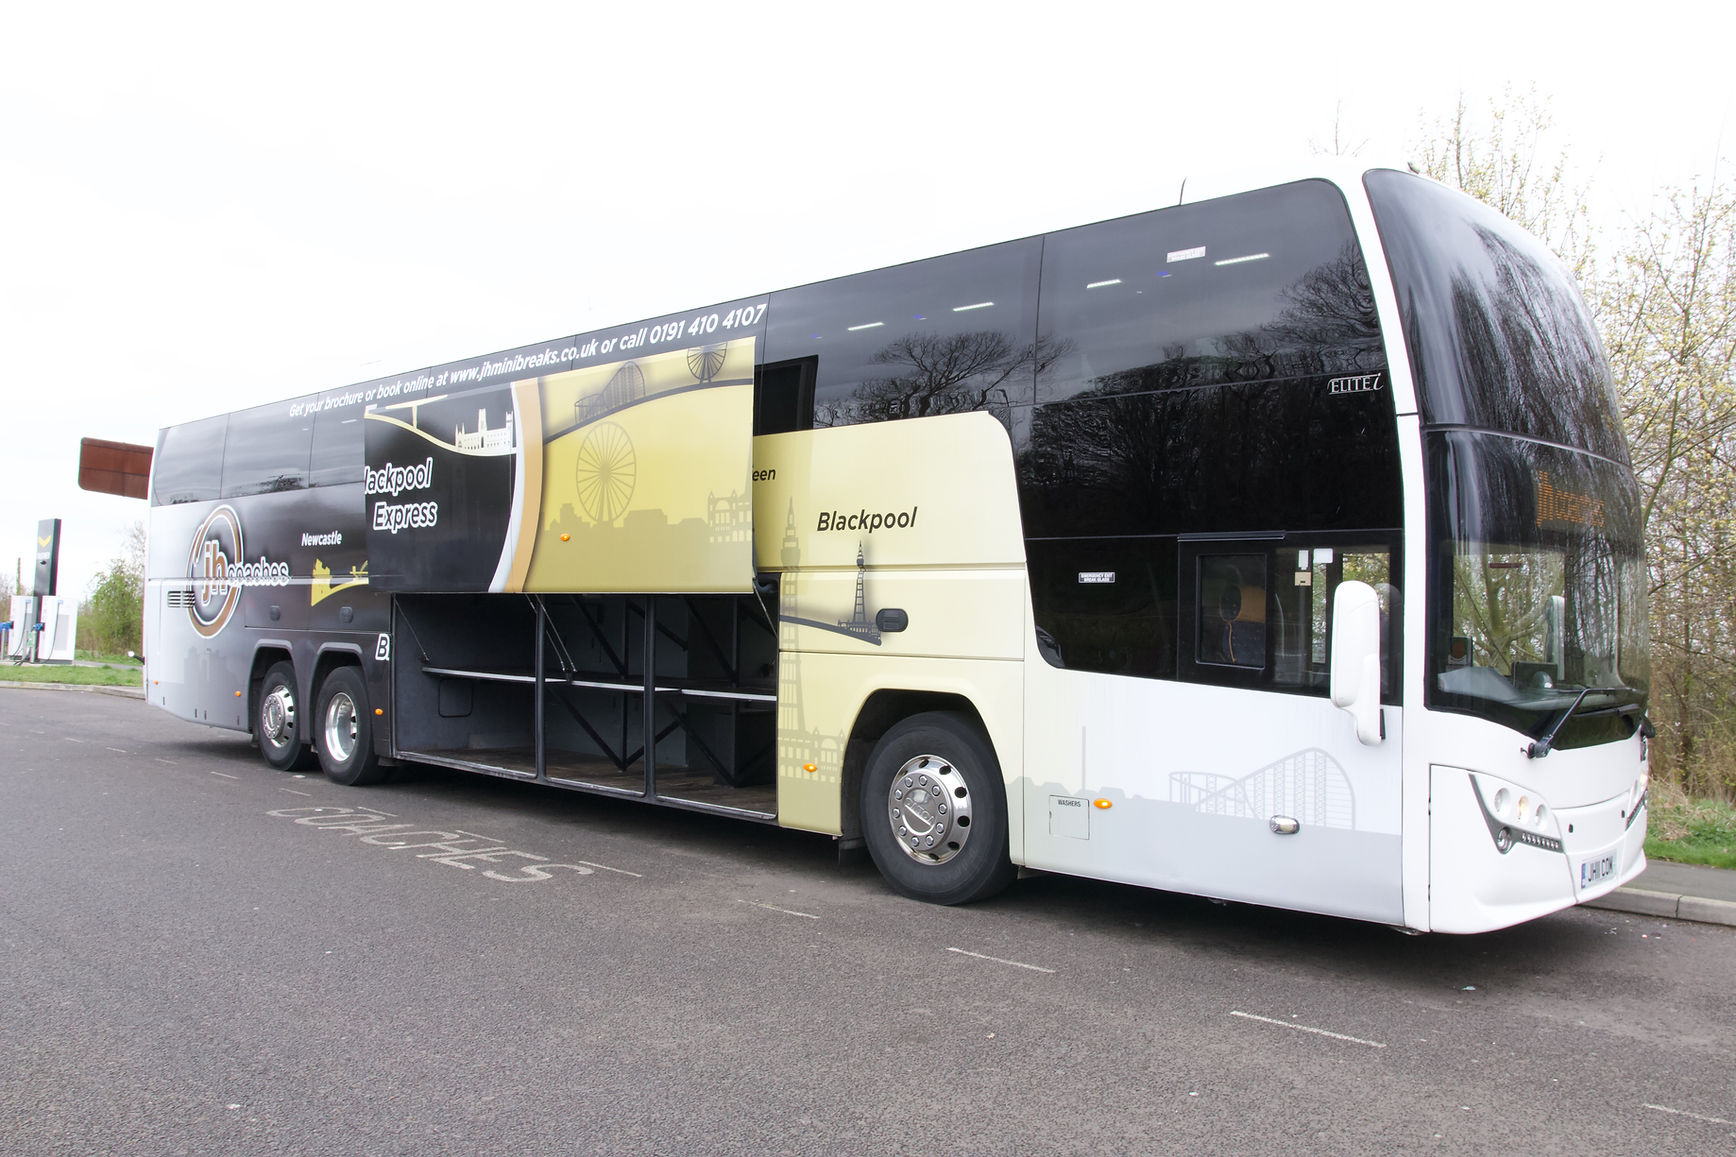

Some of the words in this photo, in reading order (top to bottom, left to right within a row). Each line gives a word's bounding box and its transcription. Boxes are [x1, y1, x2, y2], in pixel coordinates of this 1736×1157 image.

[289, 403, 304, 417] Get
[304, 398, 324, 417] your
[323, 391, 364, 410] brochure
[365, 388, 377, 402] or
[376, 380, 402, 399] book
[403, 374, 434, 394] online
[435, 370, 449, 386] at
[449, 338, 598, 384] www.jhminibreaks.co.uk
[600, 336, 618, 354] or
[619, 327, 648, 350] call
[649, 319, 686, 344] 0191
[687, 313, 719, 336] 410
[722, 303, 768, 329] 4107
[372, 501, 438, 534] Express
[816, 506, 918, 534] Blackpool
[301, 529, 343, 547] Newcastle
[1057, 799, 1082, 808] WASHERS
[265, 805, 595, 883] COACHES
